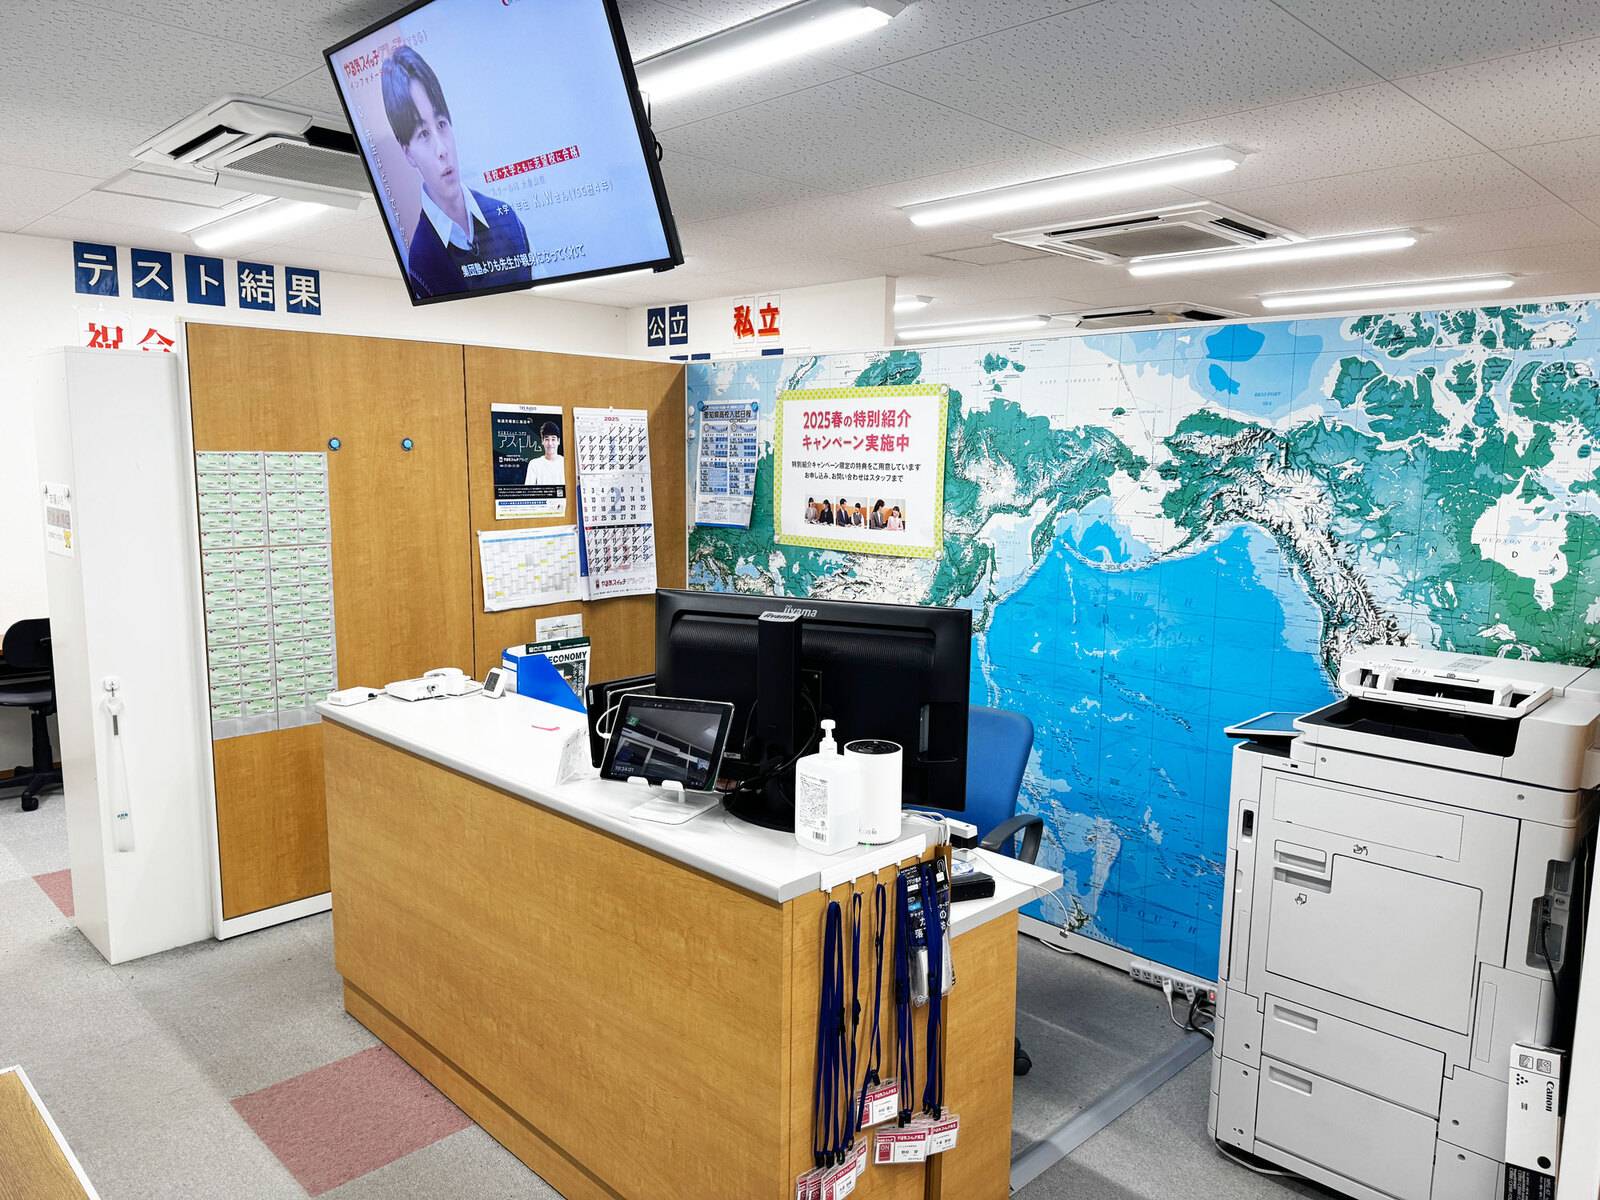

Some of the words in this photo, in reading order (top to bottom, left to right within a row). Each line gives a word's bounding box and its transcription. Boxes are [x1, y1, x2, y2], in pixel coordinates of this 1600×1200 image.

[461, 243, 586, 277] 集団塾よりも先生が親身になってくれて
[78, 253, 320, 308] テスト結果
[648, 311, 687, 340] 公立
[733, 302, 781, 340] 私立
[803, 408, 911, 430] 2025春の特別紹介
[802, 433, 910, 452] キャンペーン実施中
[783, 604, 818, 618] iiyama
[548, 651, 587, 664] ECONOMY
[1545, 1080, 1555, 1112] Canon
